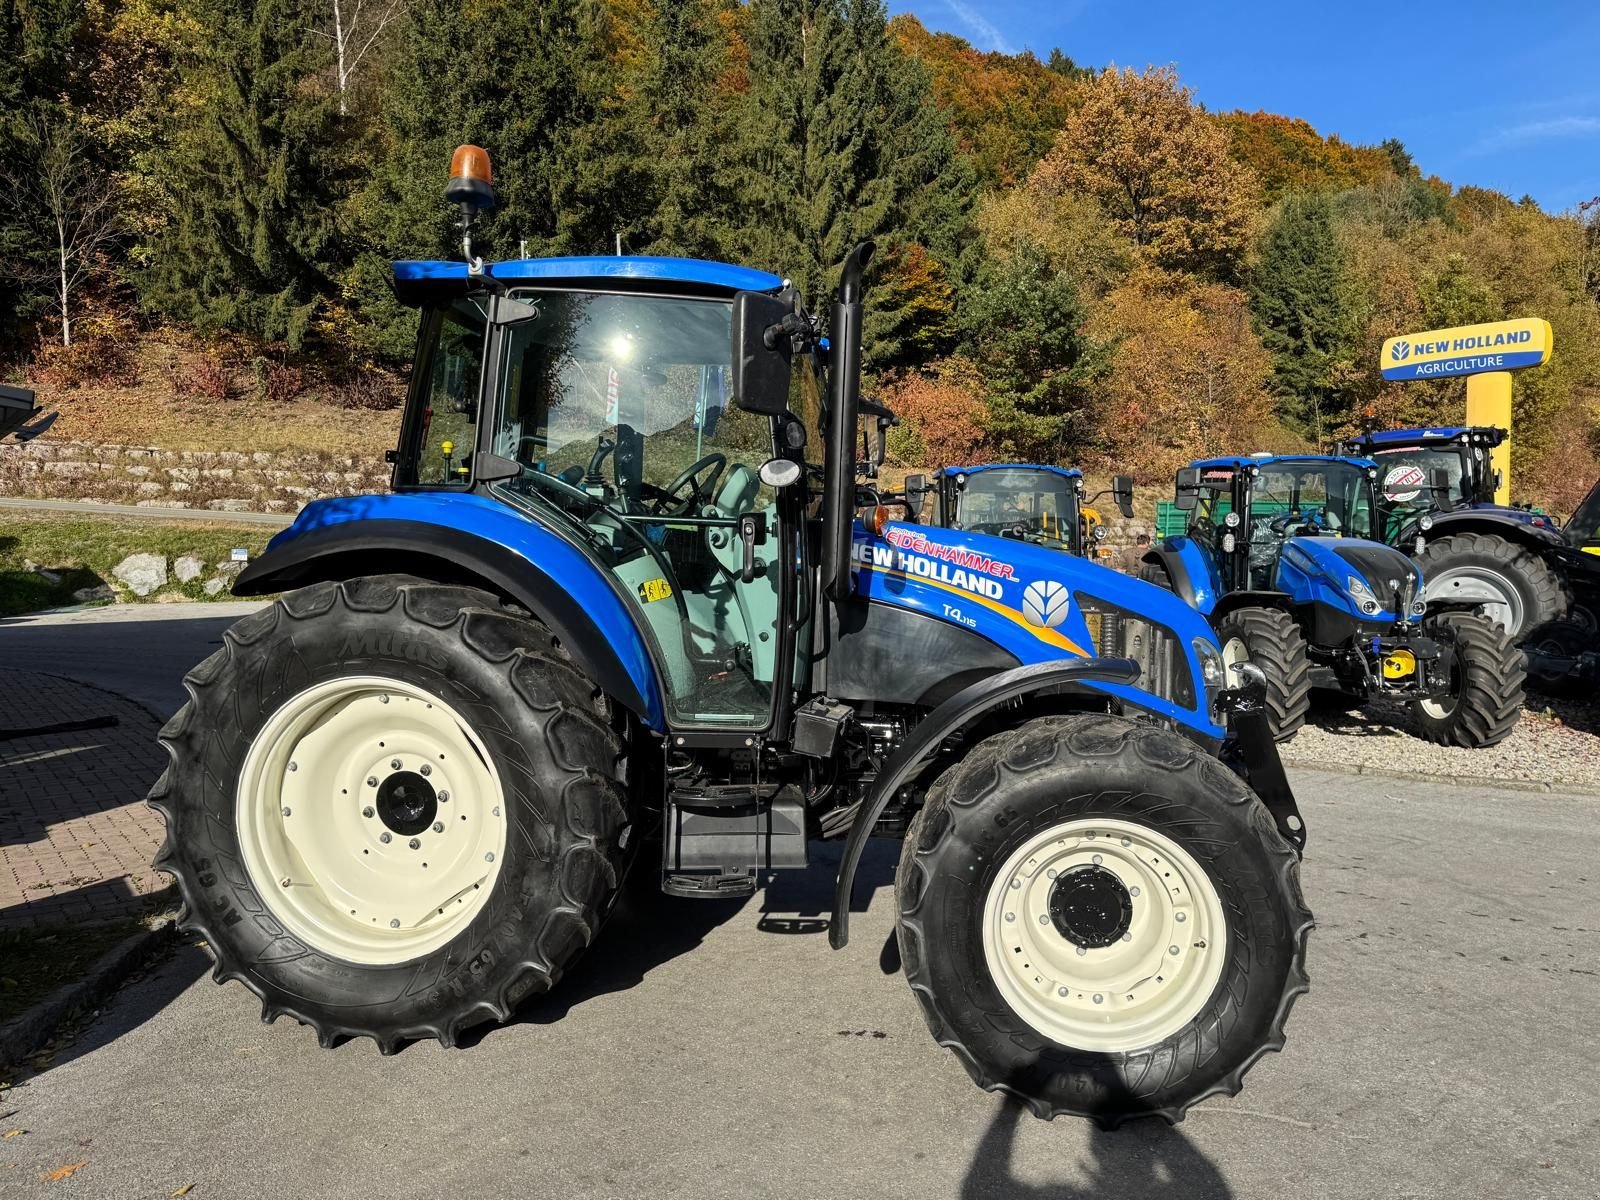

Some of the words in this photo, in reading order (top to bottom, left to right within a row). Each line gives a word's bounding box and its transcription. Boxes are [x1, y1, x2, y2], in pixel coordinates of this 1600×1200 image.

[1414, 341, 1449, 356] NEW
[1453, 330, 1531, 351] HOLLAND
[1416, 355, 1503, 375] AGRICULTURE
[886, 531, 1014, 578] EIDENHAMMER
[898, 552, 1003, 600] HOLLAND
